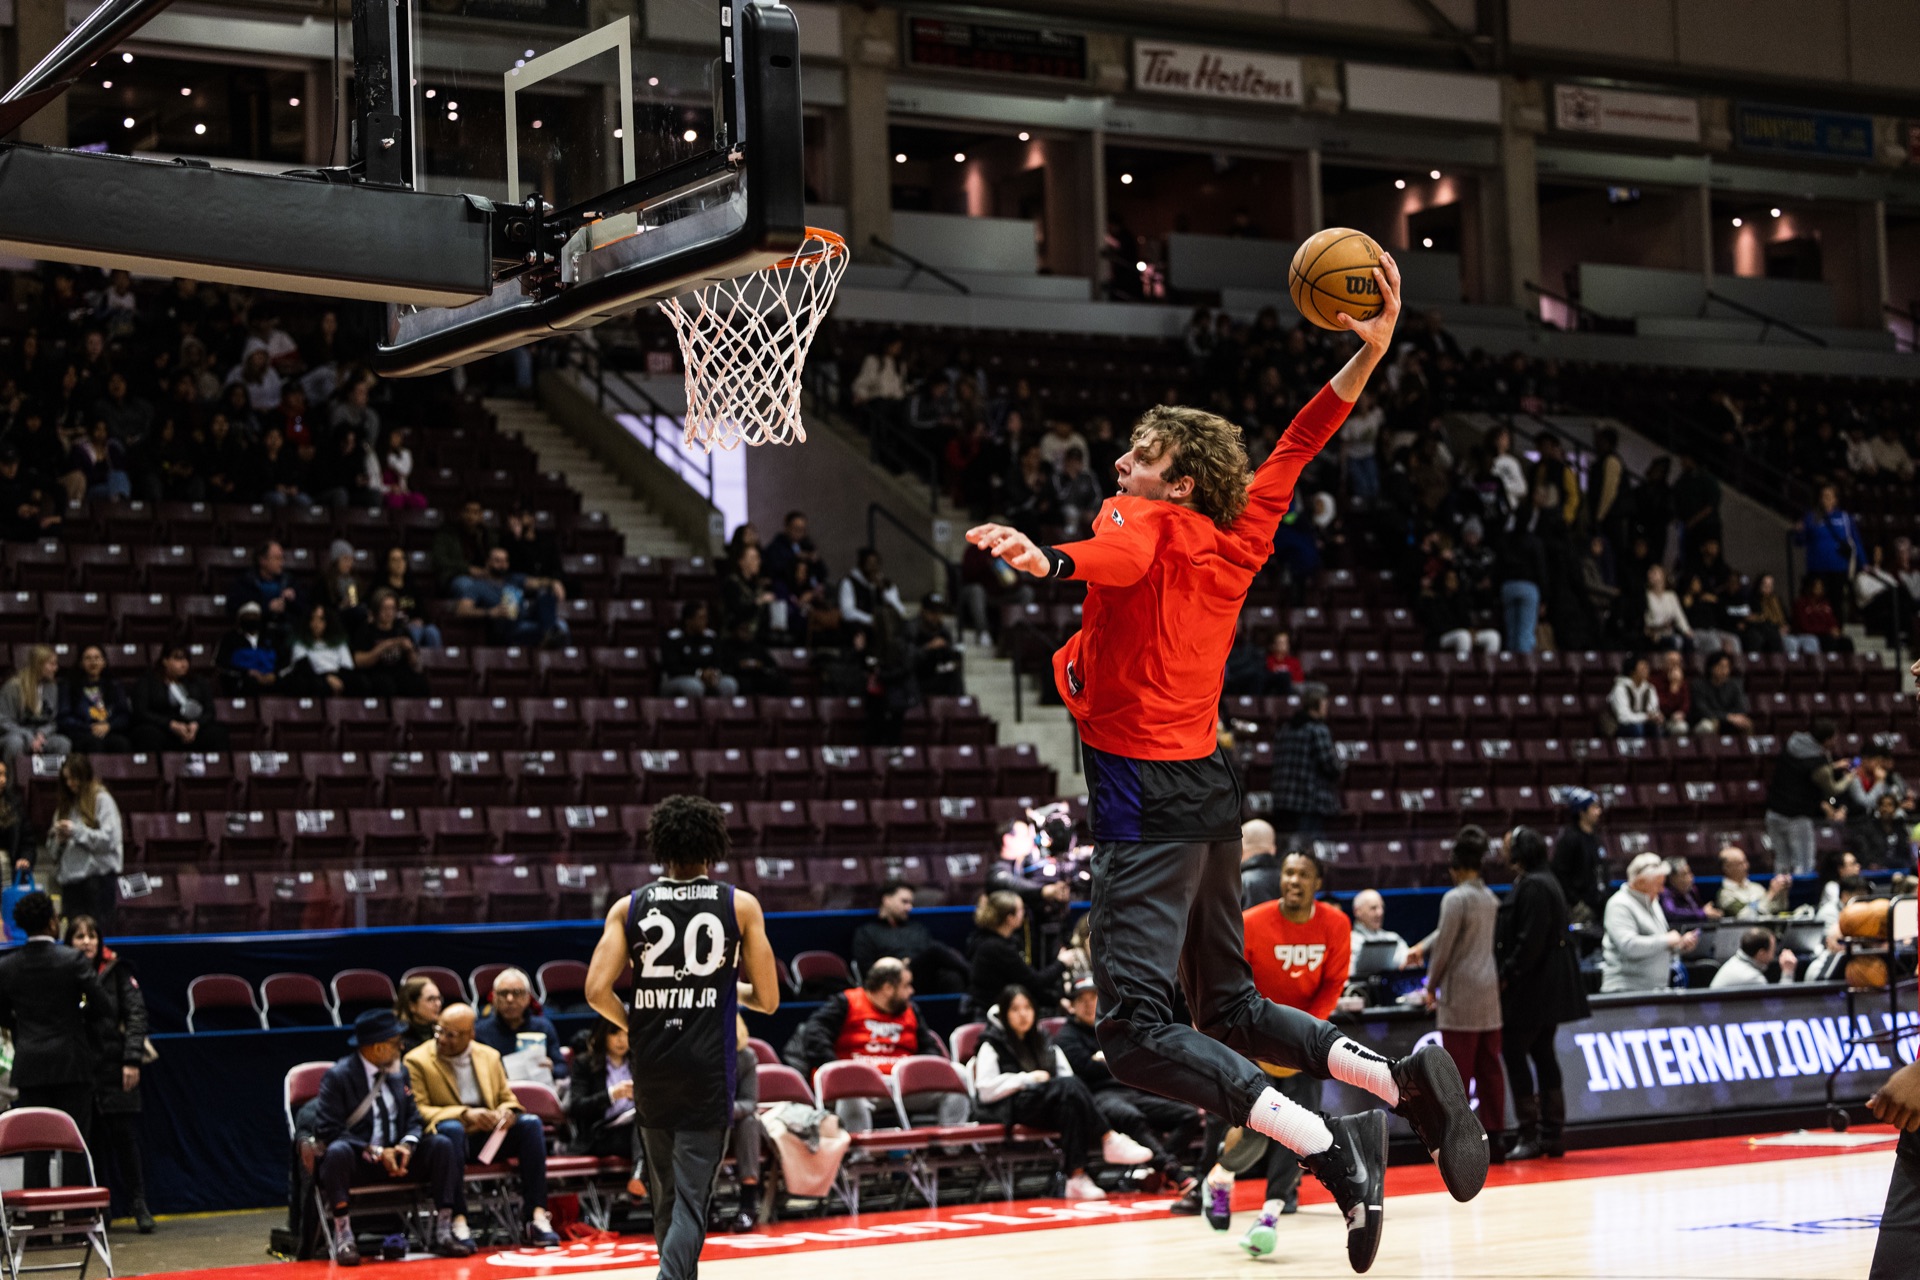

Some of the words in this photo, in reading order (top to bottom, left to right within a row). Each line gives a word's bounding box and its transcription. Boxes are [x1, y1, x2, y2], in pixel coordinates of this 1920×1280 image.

[1142, 50, 1191, 87] Tim
[1194, 55, 1294, 97] Hortons
[1345, 275, 1381, 295] Wil
[687, 884, 719, 900] LEAGUE
[638, 910, 725, 978] 20
[635, 988, 694, 1009] DOWTIN
[696, 988, 717, 1008] JR
[1574, 1014, 1893, 1092] INTERNATIONAL
